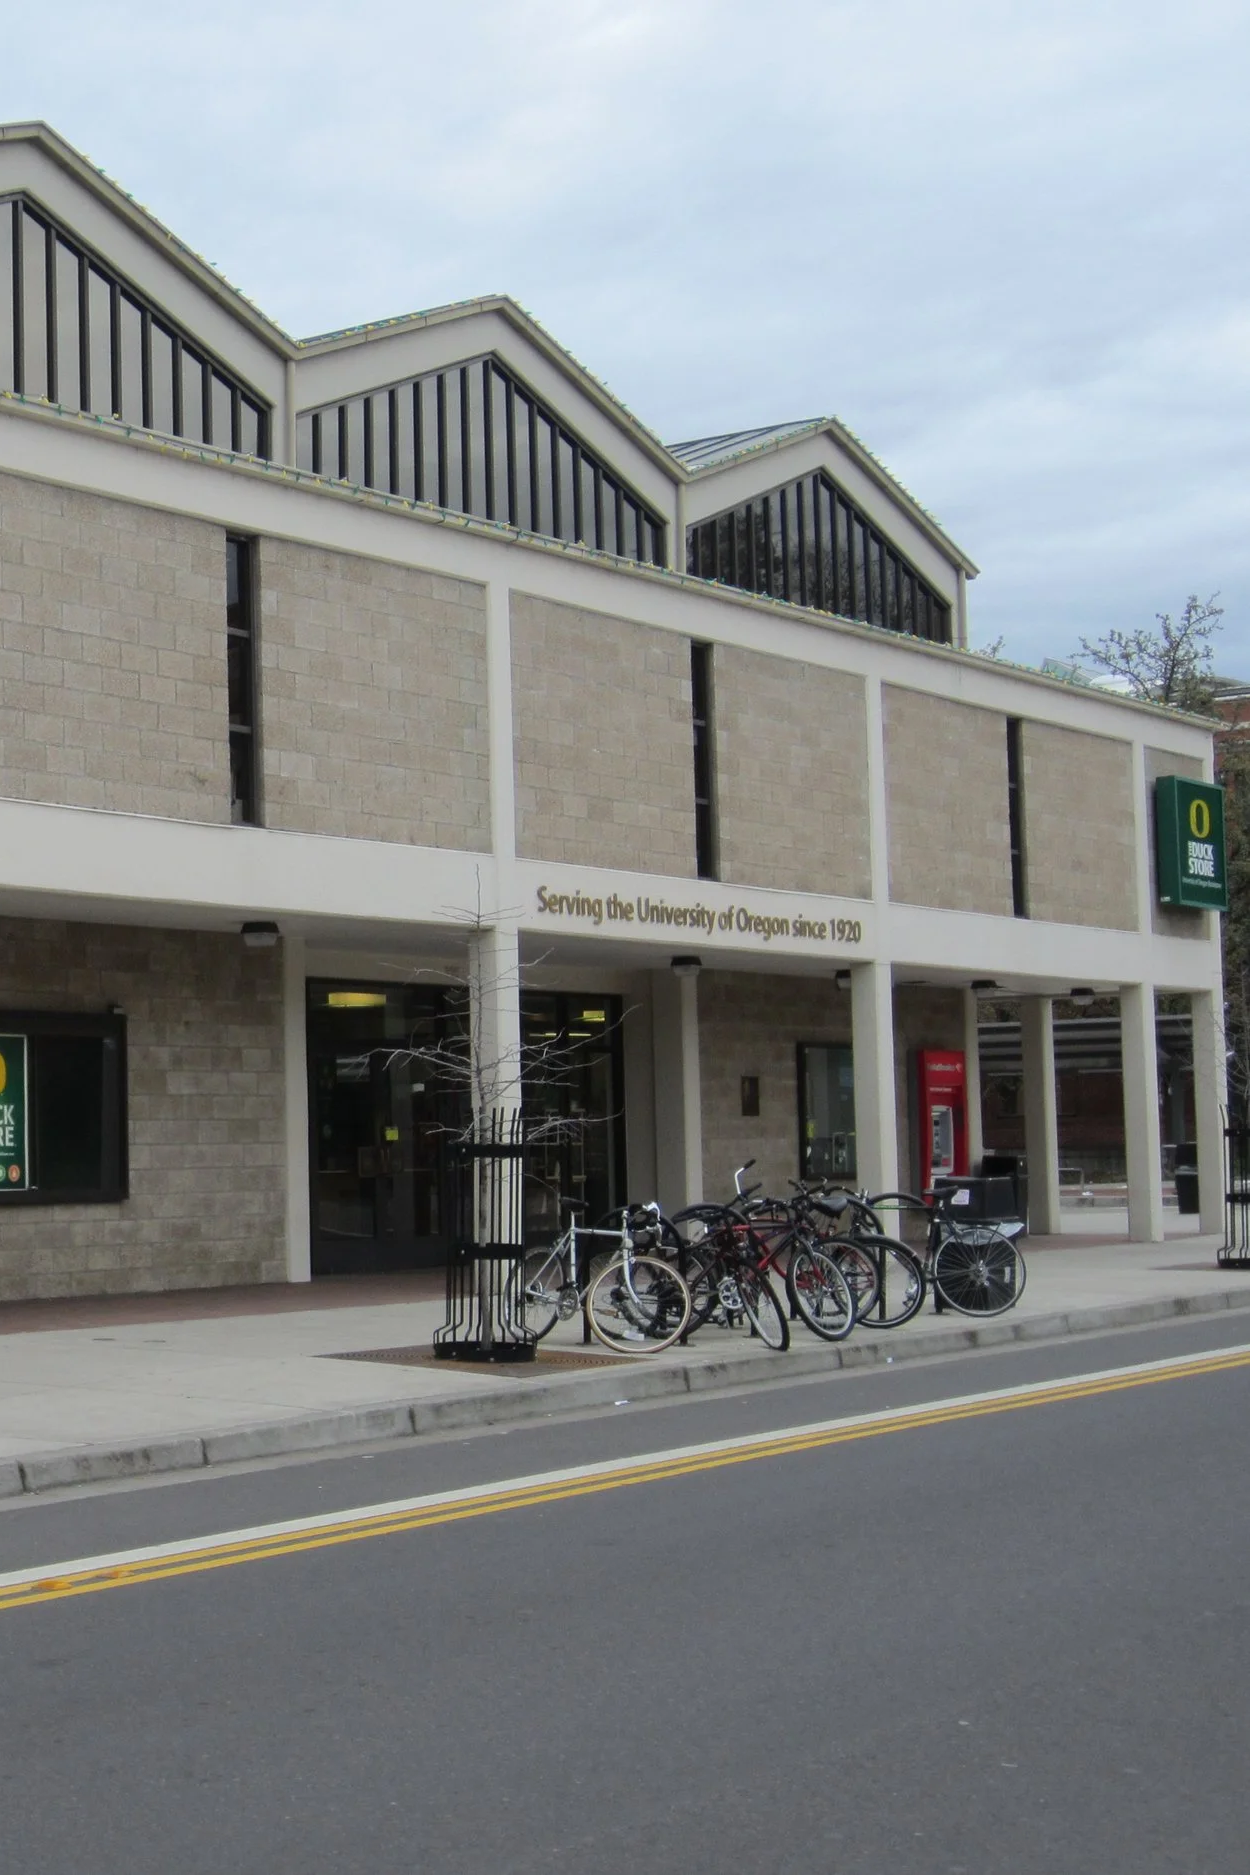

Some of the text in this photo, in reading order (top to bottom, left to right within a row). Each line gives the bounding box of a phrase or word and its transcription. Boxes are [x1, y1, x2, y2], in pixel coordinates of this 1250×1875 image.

[1192, 841, 1214, 860] DUCK
[1188, 857, 1215, 877] STORE
[536, 885, 862, 943] Serving the University of Oregon since 1920
